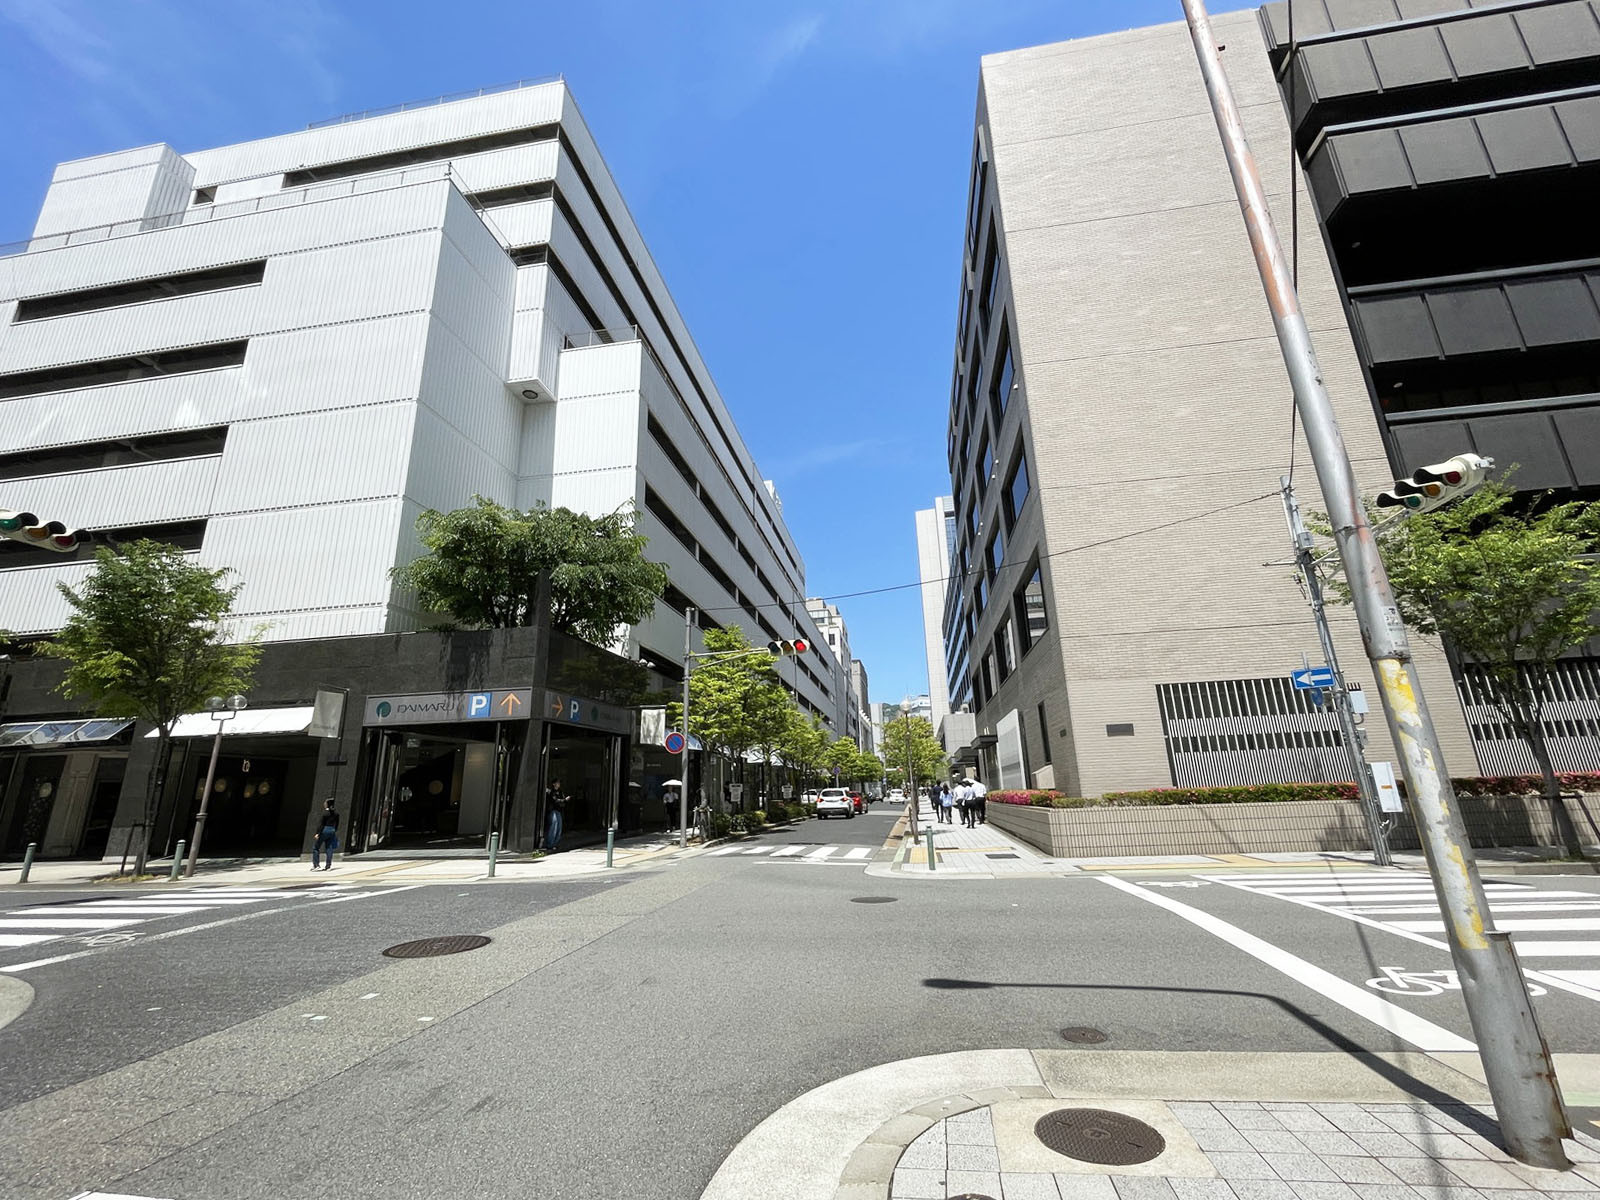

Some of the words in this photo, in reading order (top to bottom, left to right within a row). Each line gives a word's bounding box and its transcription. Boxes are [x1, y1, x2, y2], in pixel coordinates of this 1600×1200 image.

[397, 698, 454, 714] DAIMARU
[470, 695, 487, 716] P
[570, 700, 579, 719] P
